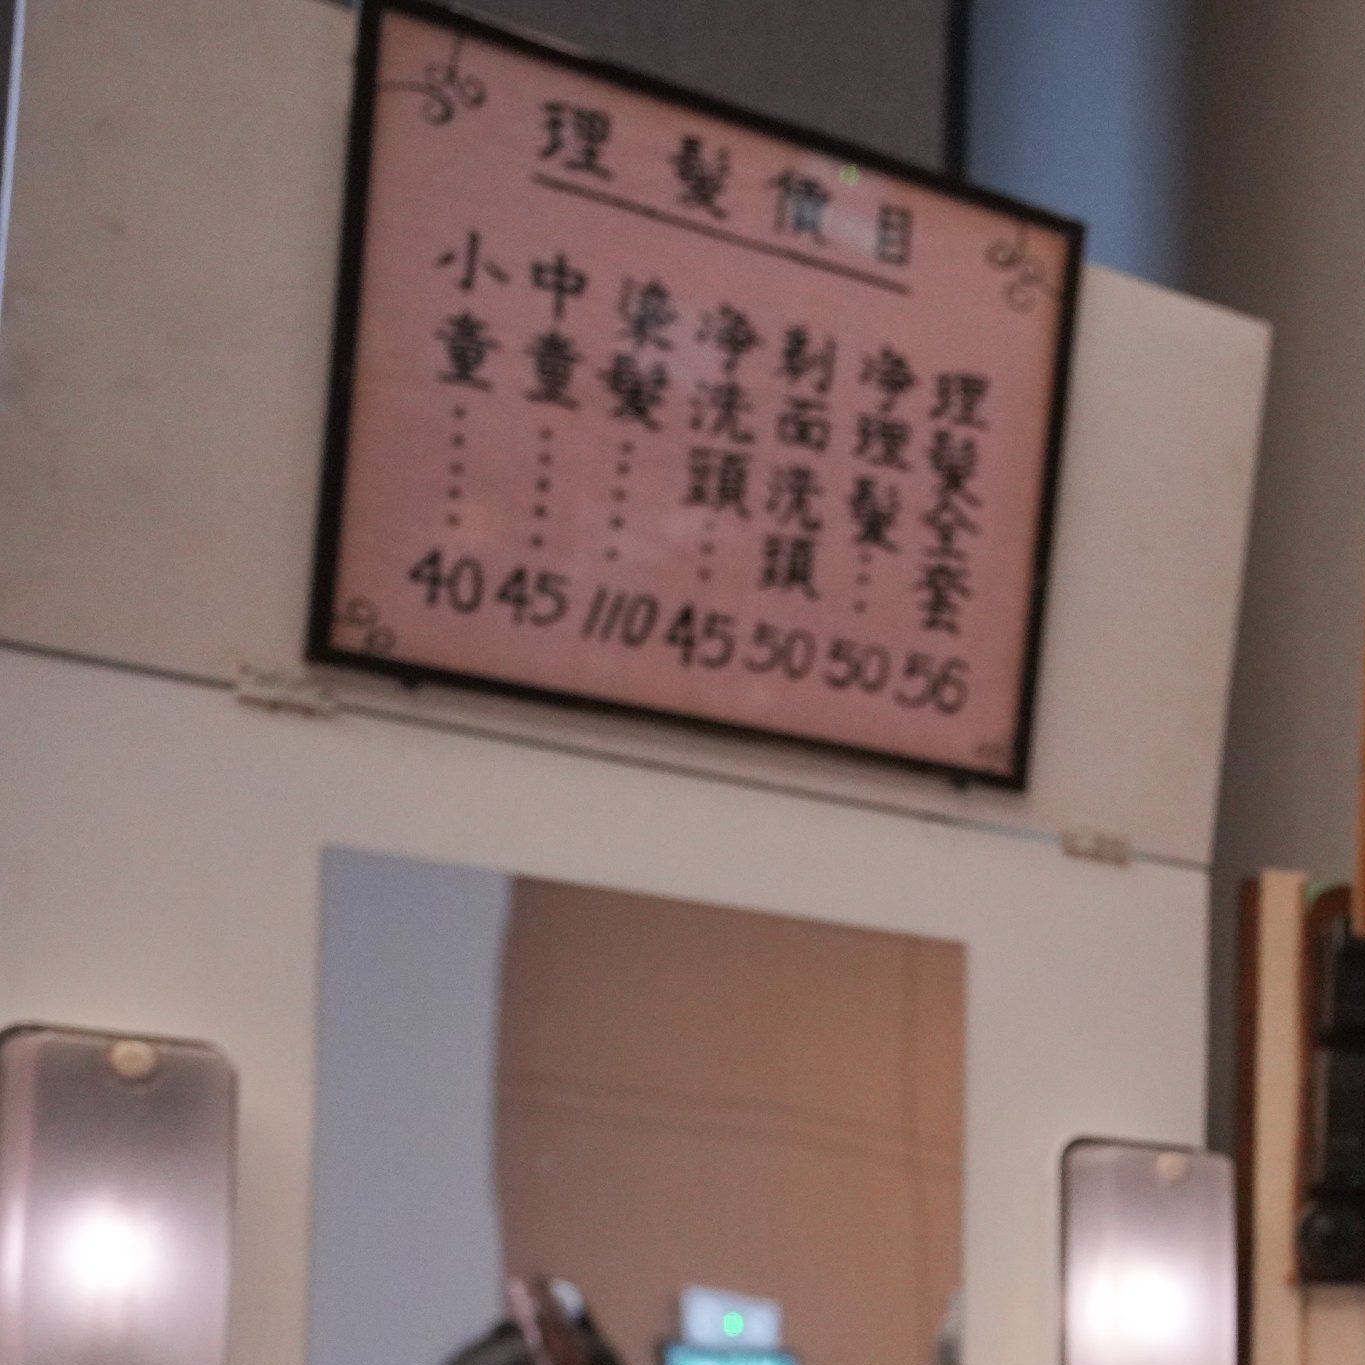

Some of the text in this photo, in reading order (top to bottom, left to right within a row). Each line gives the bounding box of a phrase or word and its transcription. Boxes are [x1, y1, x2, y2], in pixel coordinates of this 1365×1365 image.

[539, 101, 914, 267] 理髮價目
[406, 229, 508, 615] 小童 40
[496, 252, 589, 628] 中童 45
[578, 274, 680, 648] 染髮 110
[893, 373, 989, 716] 理髮全套 56
[664, 602, 737, 670] 45
[743, 619, 818, 682] 50
[824, 635, 893, 694] 50
